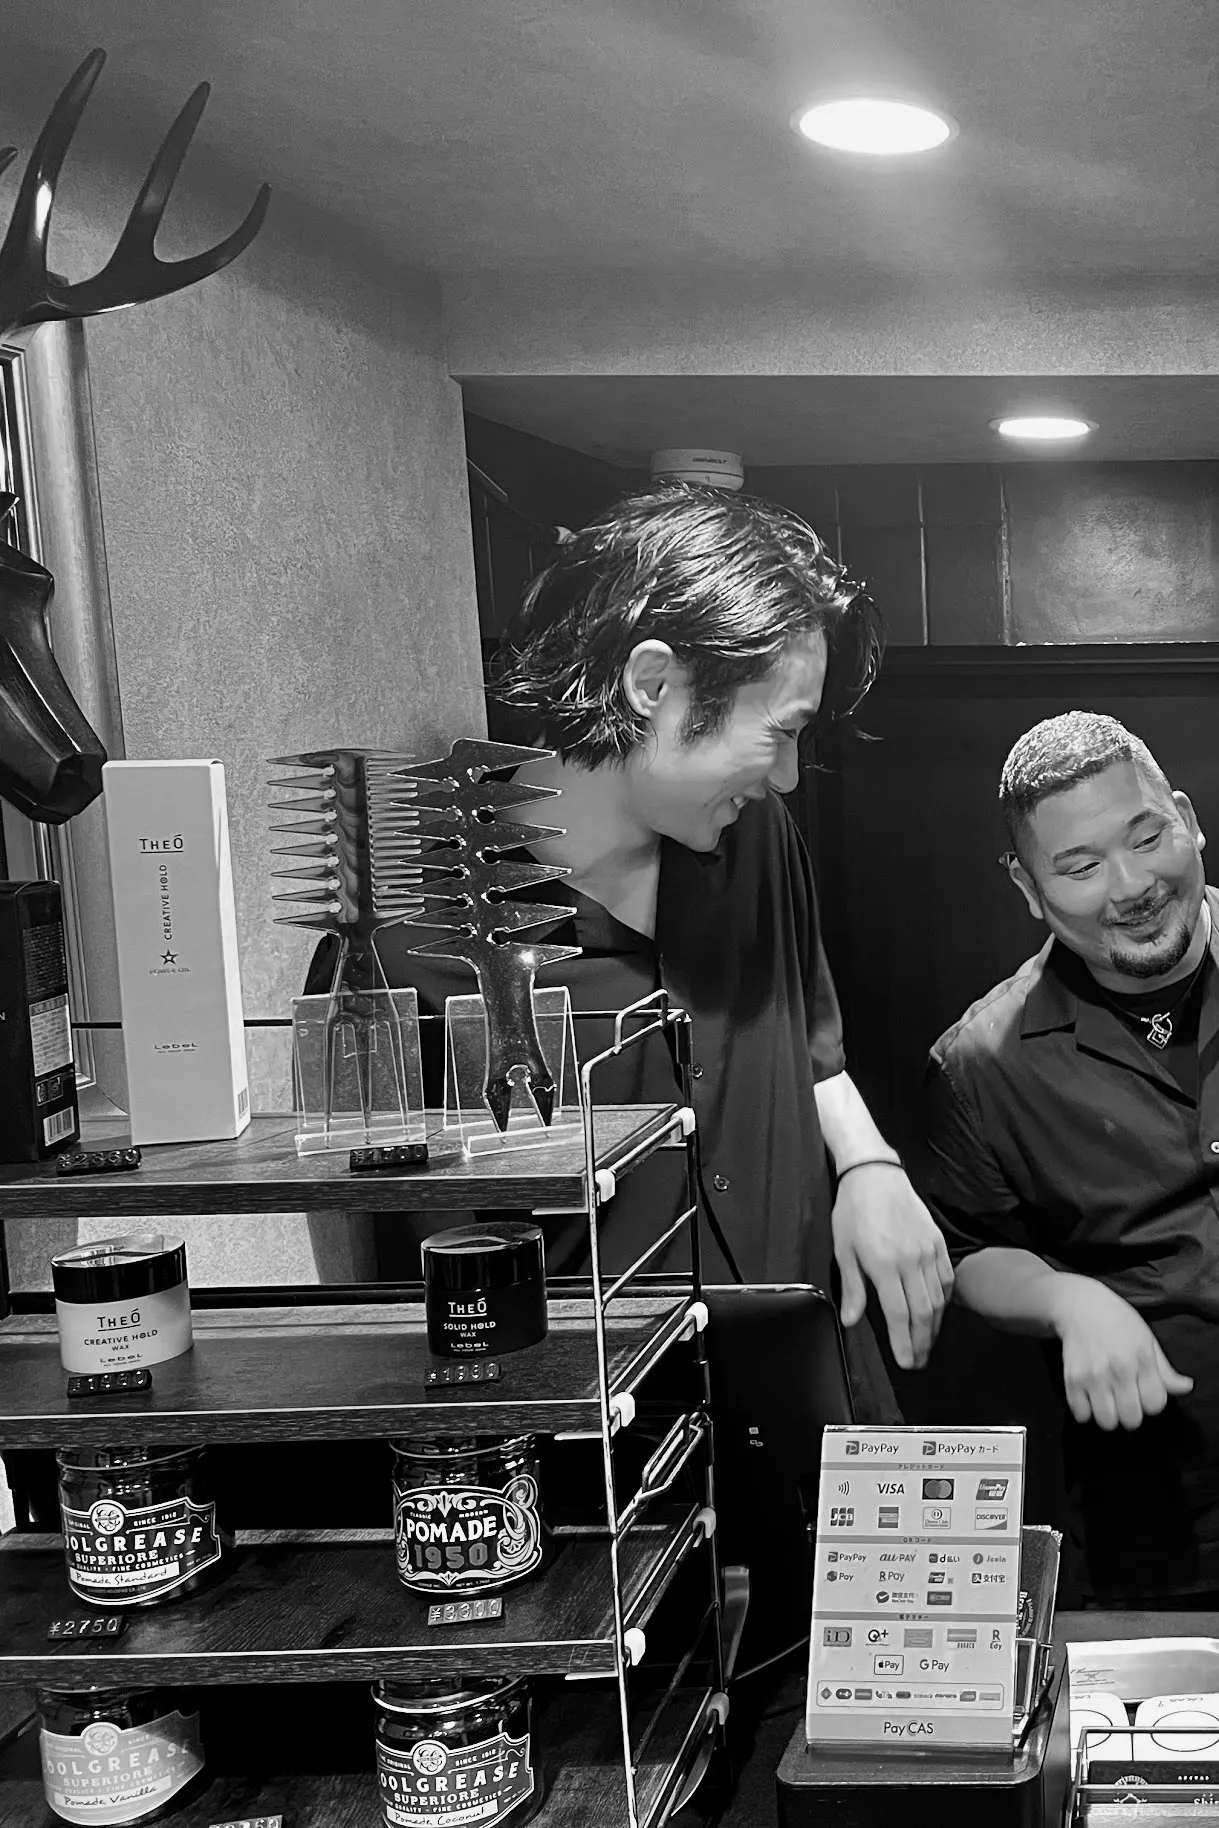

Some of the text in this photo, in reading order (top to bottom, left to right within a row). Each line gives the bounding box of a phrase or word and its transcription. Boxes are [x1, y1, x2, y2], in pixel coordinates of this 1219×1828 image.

[159, 864, 173, 940] CREATIVE HOLD
[471, 1321, 496, 1329] HOLD
[84, 1329, 158, 1345] CREATIVE HOLD
[861, 1443, 899, 1454] PayPay
[938, 1443, 999, 1455] PayPay カード
[877, 1483, 905, 1494] VISA
[133, 1516, 156, 1526] SINCE
[406, 1516, 498, 1543] POMADE
[75, 1550, 158, 1566] SUPERIORE
[414, 1542, 489, 1570] 1950
[839, 1553, 867, 1562] PayPay
[899, 1554, 916, 1562] PAY
[839, 1572, 854, 1582] Pay
[888, 1571, 905, 1582] Pay
[49, 1618, 118, 1635] ¥2750
[884, 1660, 900, 1671] Pay
[931, 1660, 950, 1672] Pay
[455, 1756, 478, 1767] SINCE
[64, 1766, 153, 1787] SUPERIORE
[110, 1784, 157, 1803] Vanilla
[394, 1788, 480, 1807] SUPERIORE
